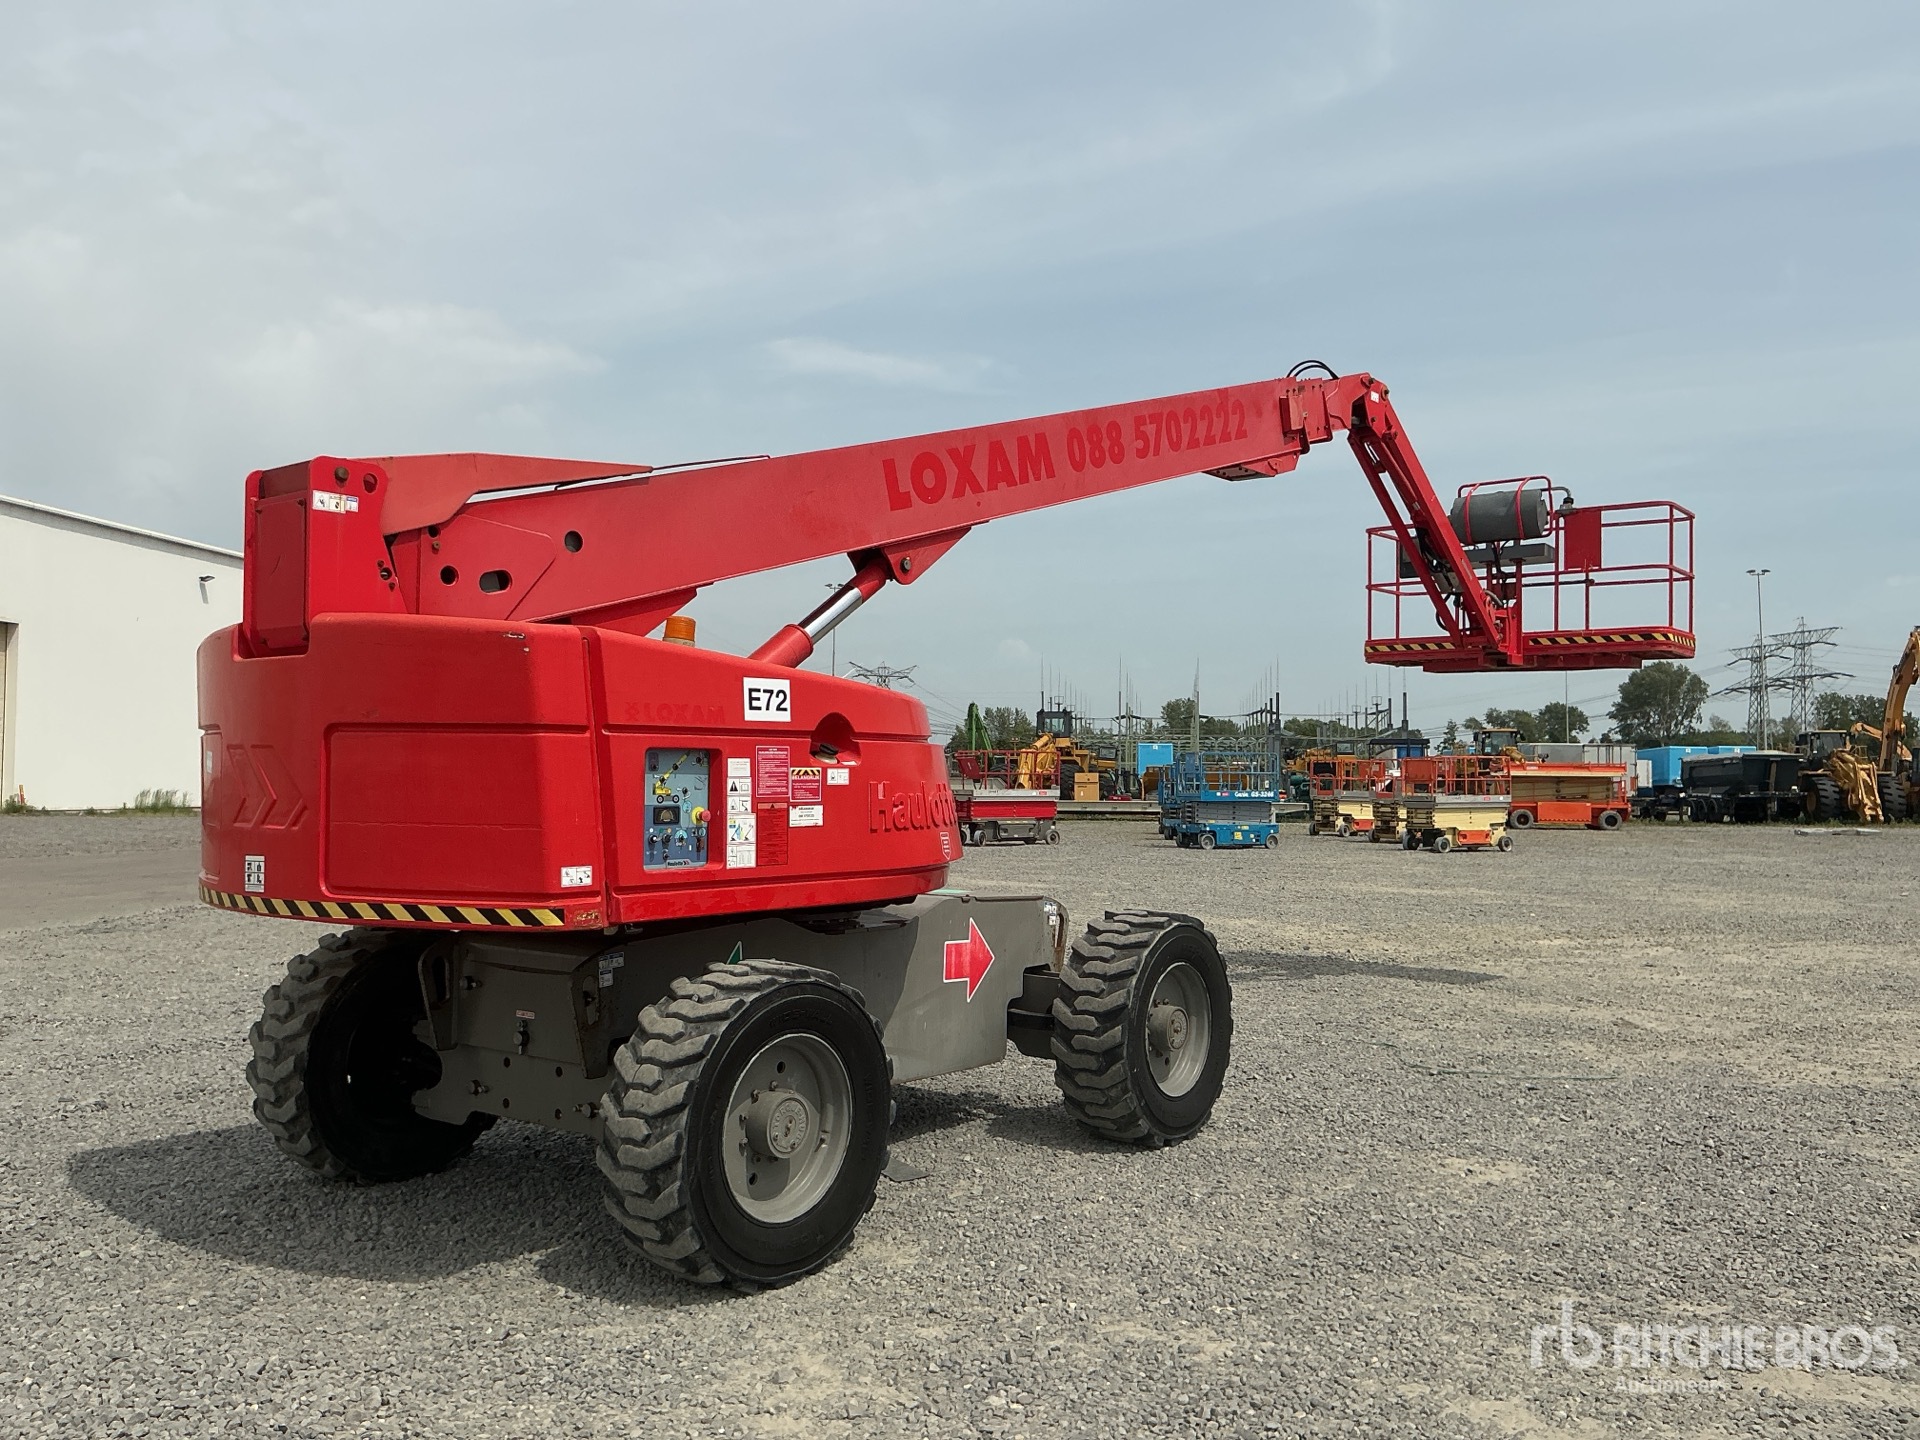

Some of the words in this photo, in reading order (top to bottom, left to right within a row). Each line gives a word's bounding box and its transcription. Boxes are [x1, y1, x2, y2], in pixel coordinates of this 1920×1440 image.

[882, 432, 1056, 511] LOXAM
[1066, 420, 1125, 472] 088
[1134, 399, 1248, 459] 5702222
[748, 688, 788, 712] E72
[643, 702, 725, 724] LOXAM
